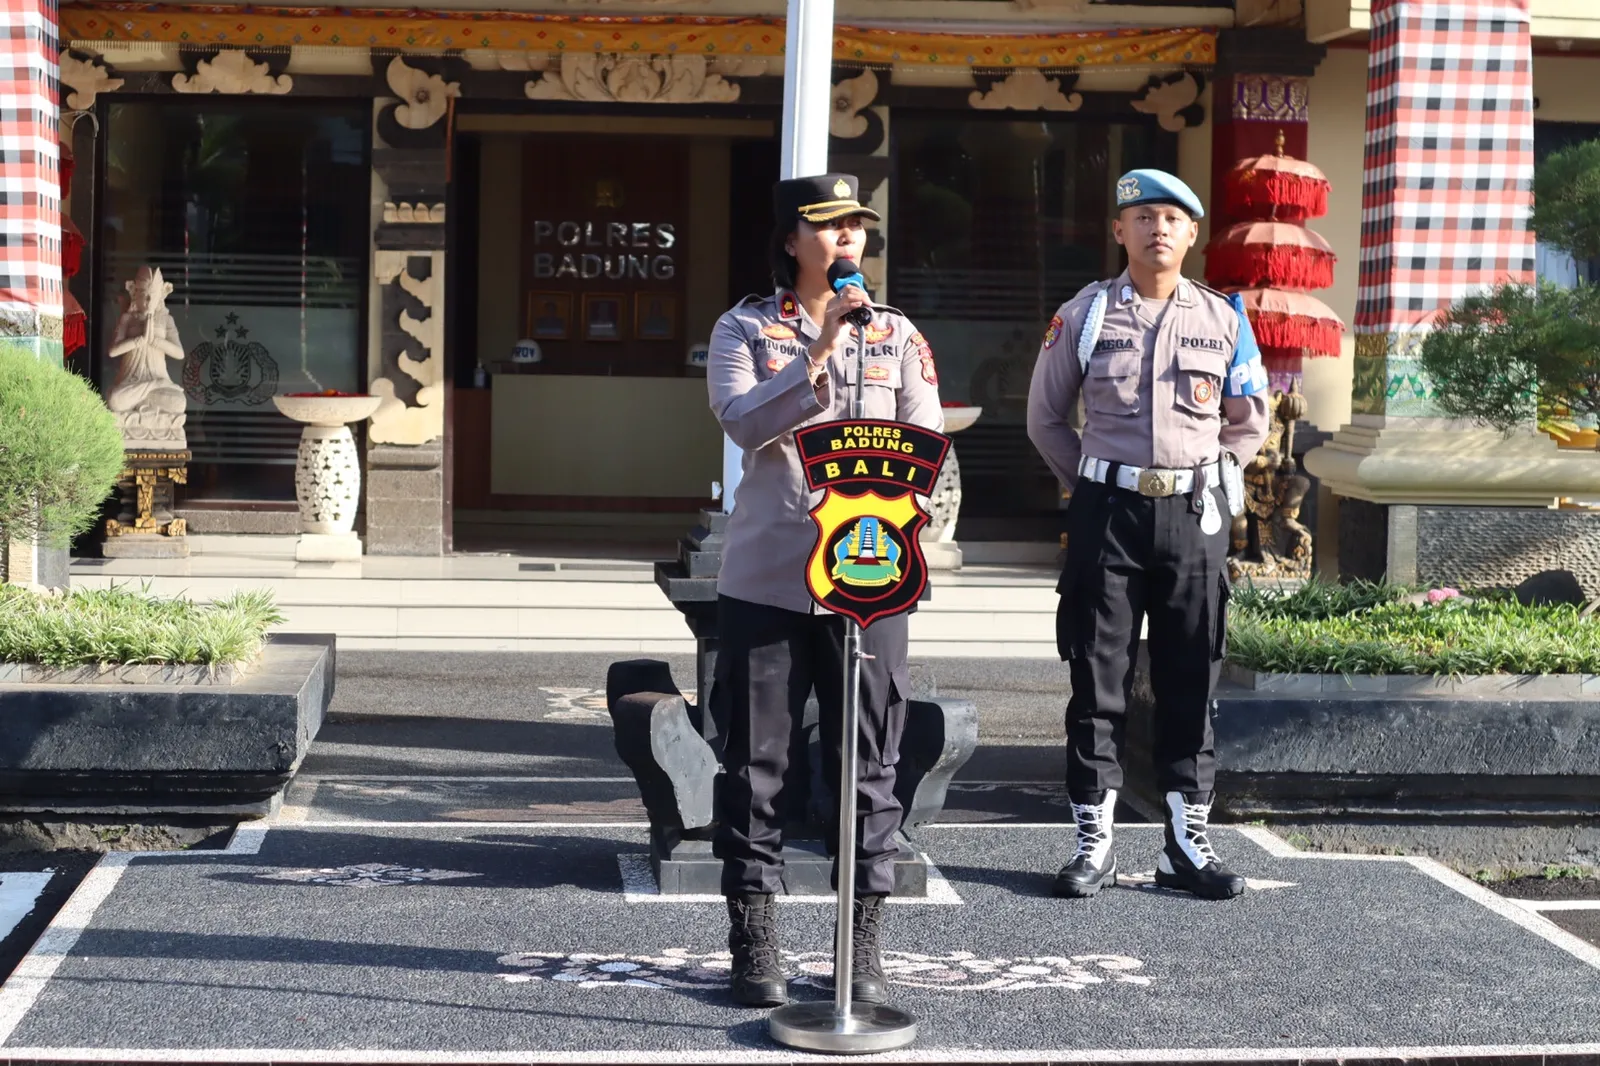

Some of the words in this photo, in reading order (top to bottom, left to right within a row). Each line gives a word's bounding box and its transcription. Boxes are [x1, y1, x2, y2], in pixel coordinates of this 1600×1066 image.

[534, 220, 676, 248] POLRES
[533, 253, 675, 280] BADUNG
[1095, 338, 1136, 351] MEGA
[1180, 336, 1224, 351] POLRI
[843, 426, 902, 439] POLRES
[831, 437, 914, 454] BADUNG
[824, 459, 917, 482] BALI
